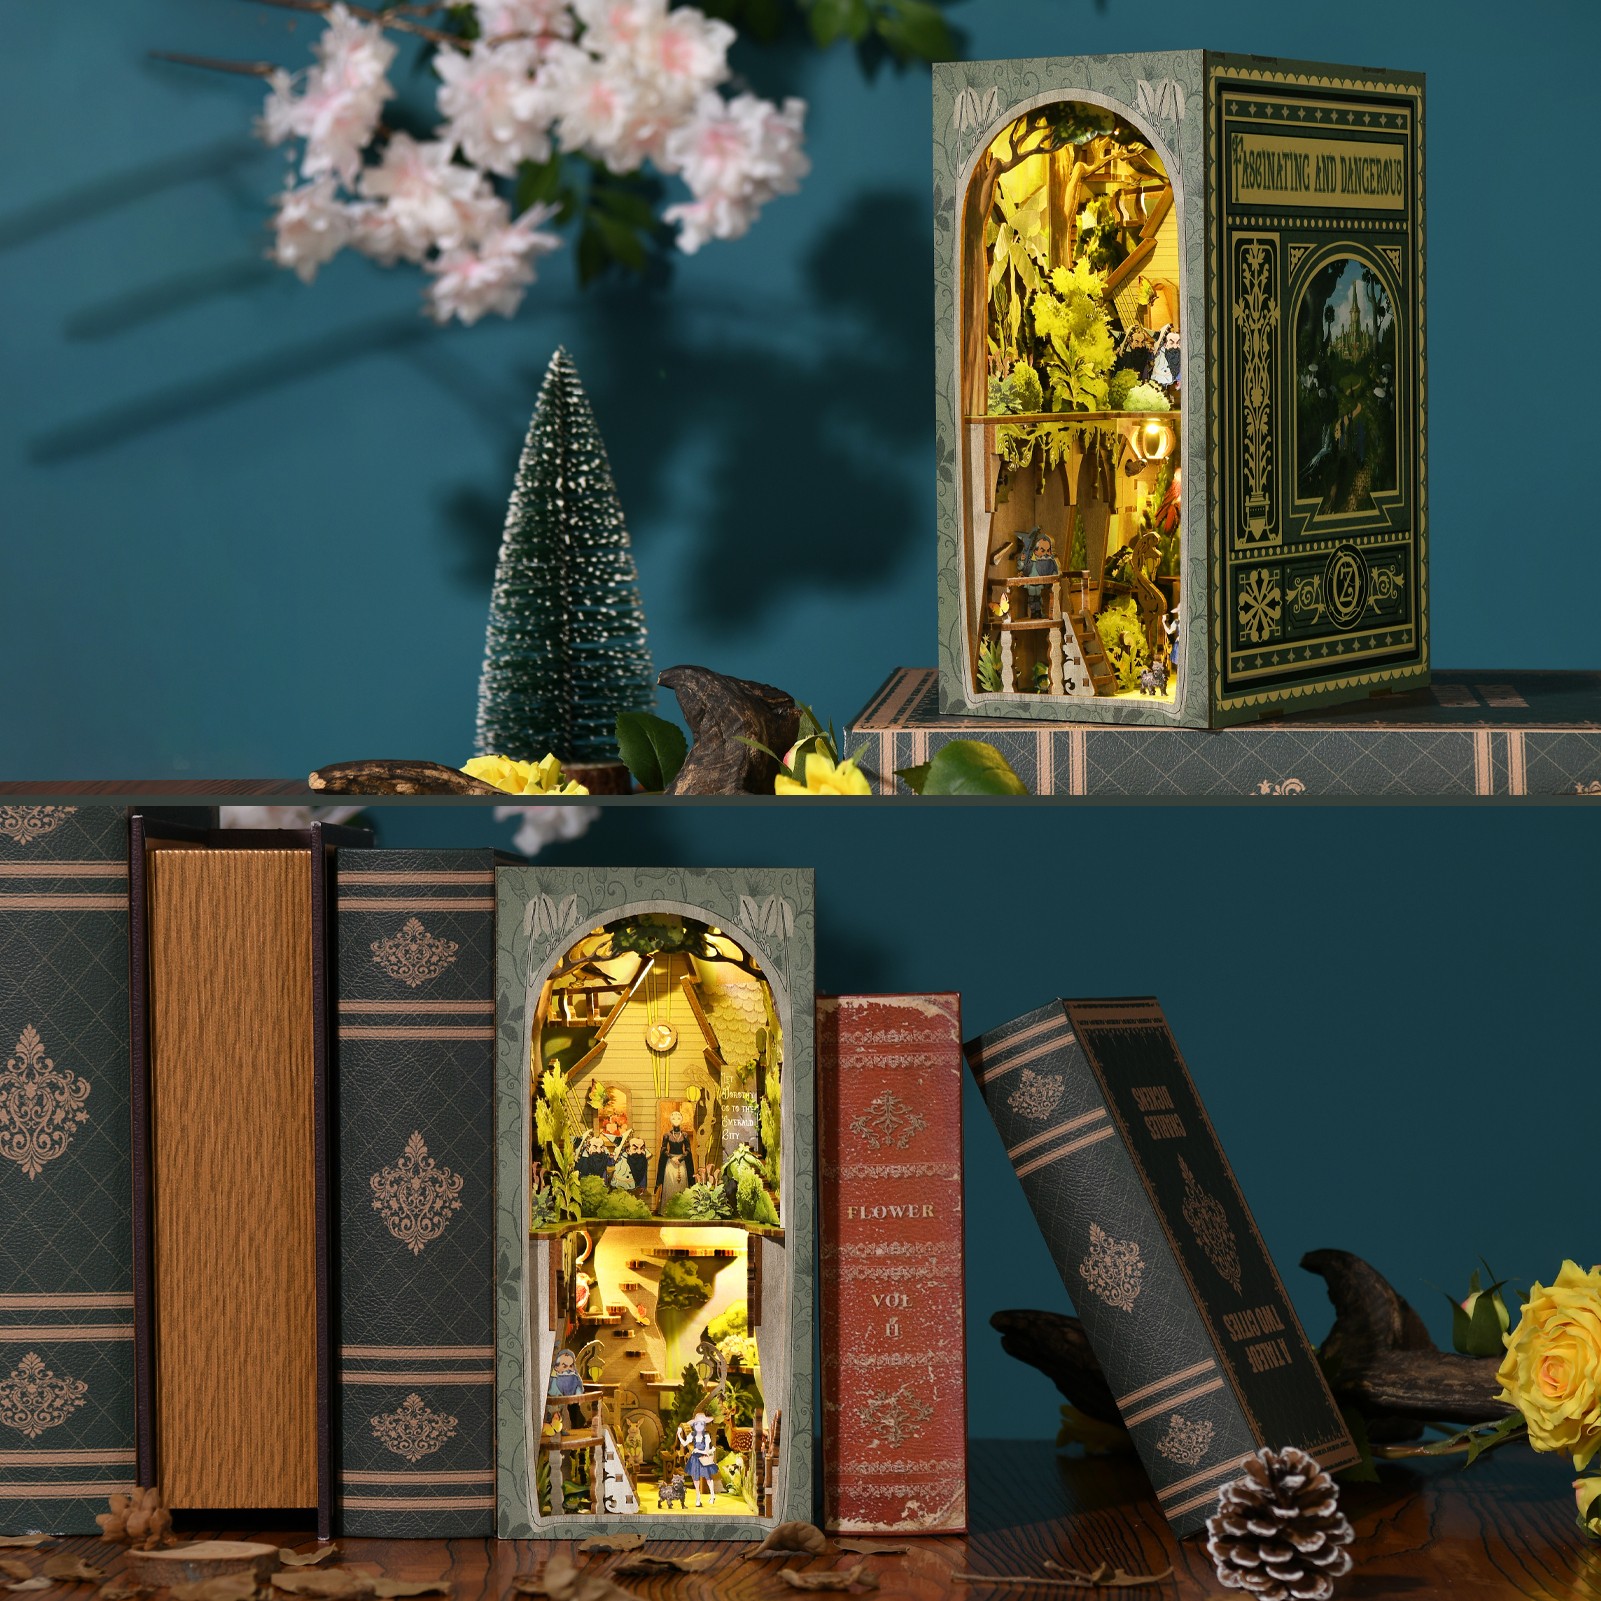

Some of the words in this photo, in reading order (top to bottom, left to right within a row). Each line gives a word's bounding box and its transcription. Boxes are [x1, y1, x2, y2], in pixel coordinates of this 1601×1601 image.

[1232, 134, 1310, 202] FASCINATING
[1314, 152, 1337, 194] AND
[1340, 154, 1402, 196] DANGEROUS
[732, 1105, 740, 1113] TO
[847, 1204, 935, 1220] FLOWER
[871, 1293, 913, 1308] VOL
